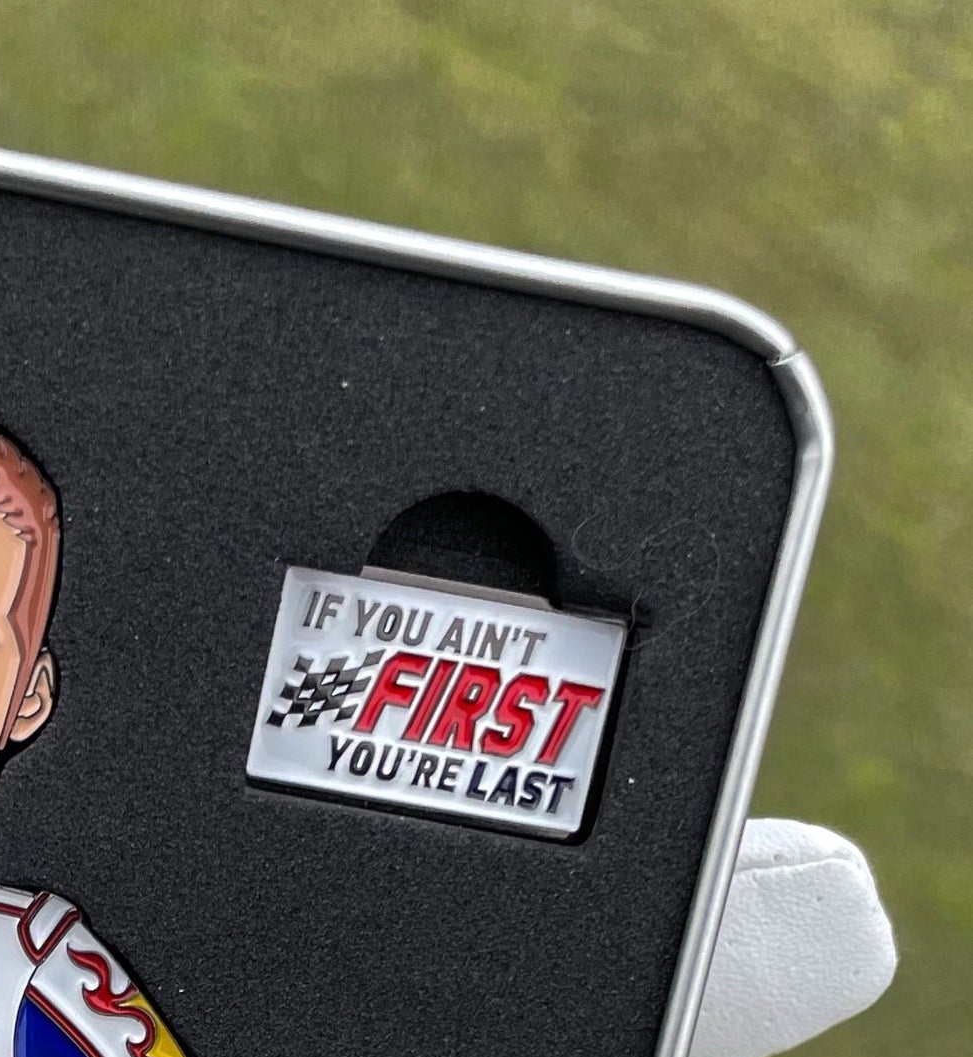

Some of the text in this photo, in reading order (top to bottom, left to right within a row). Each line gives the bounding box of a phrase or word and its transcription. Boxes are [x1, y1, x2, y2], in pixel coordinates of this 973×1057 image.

[302, 590, 547, 665] IF YOU AIN'T
[351, 651, 606, 767] FIRST
[327, 733, 576, 815] YOU'RE LAST
